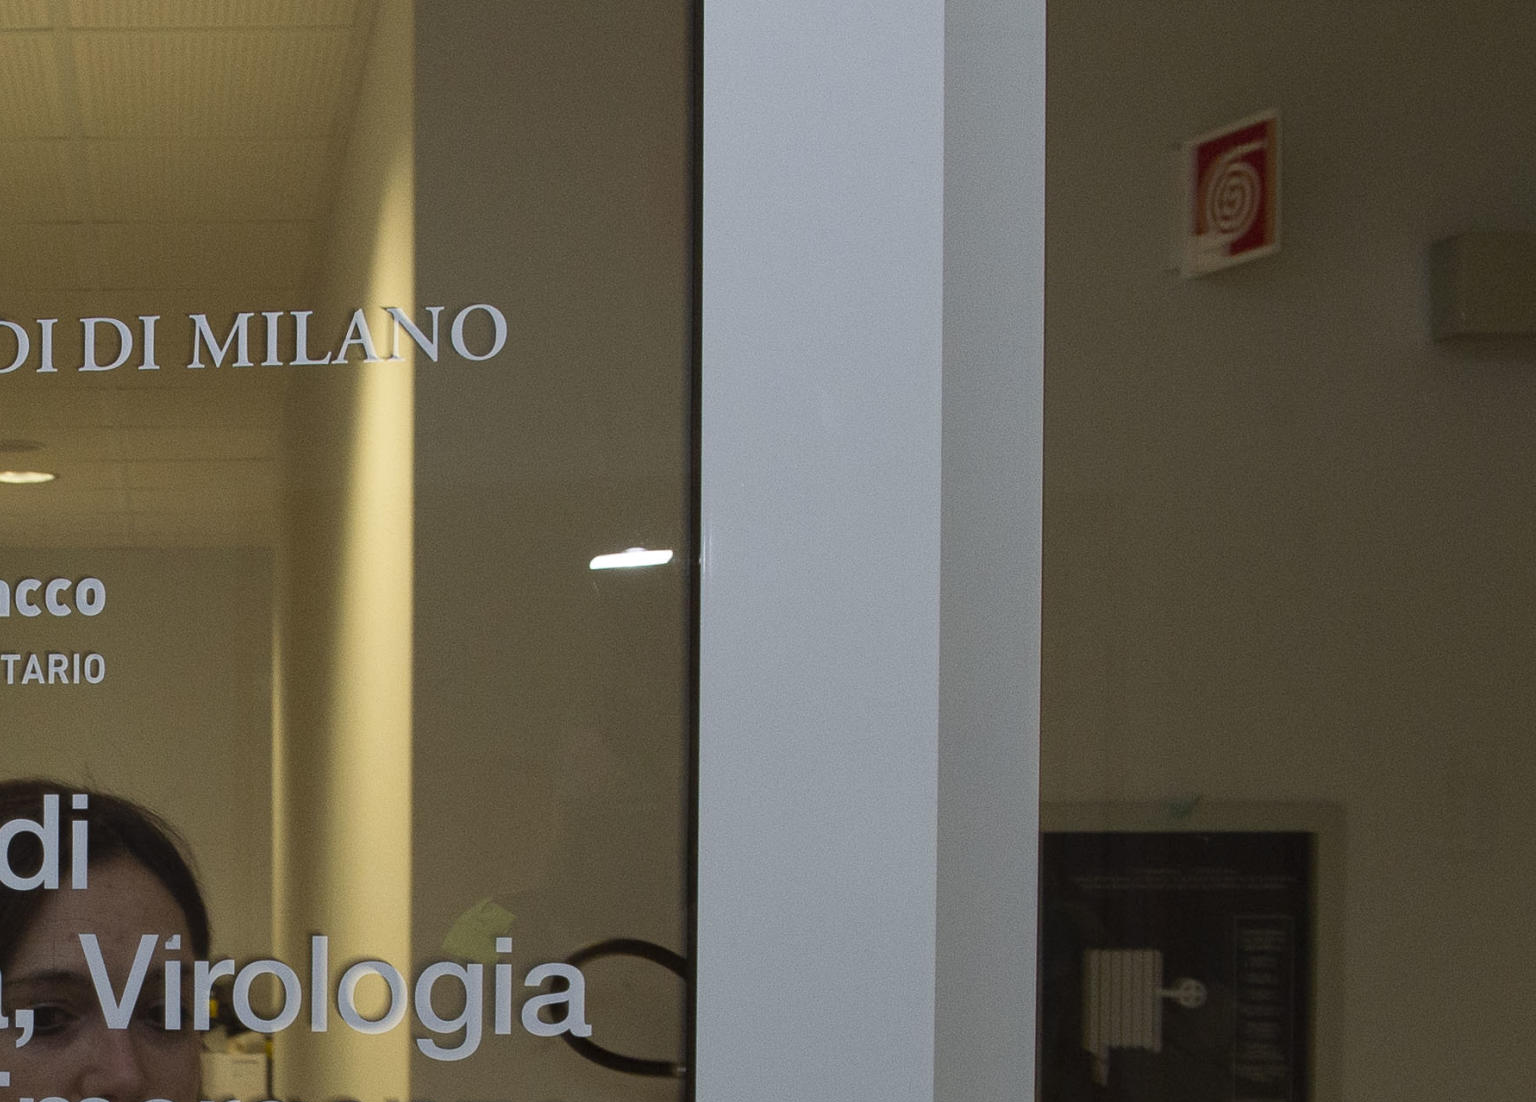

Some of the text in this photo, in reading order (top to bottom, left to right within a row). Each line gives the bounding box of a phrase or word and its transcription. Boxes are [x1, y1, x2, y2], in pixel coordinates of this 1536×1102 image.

[78, 315, 161, 372] DI
[187, 303, 508, 370] MILANO
[80, 933, 593, 1061] Virologia
